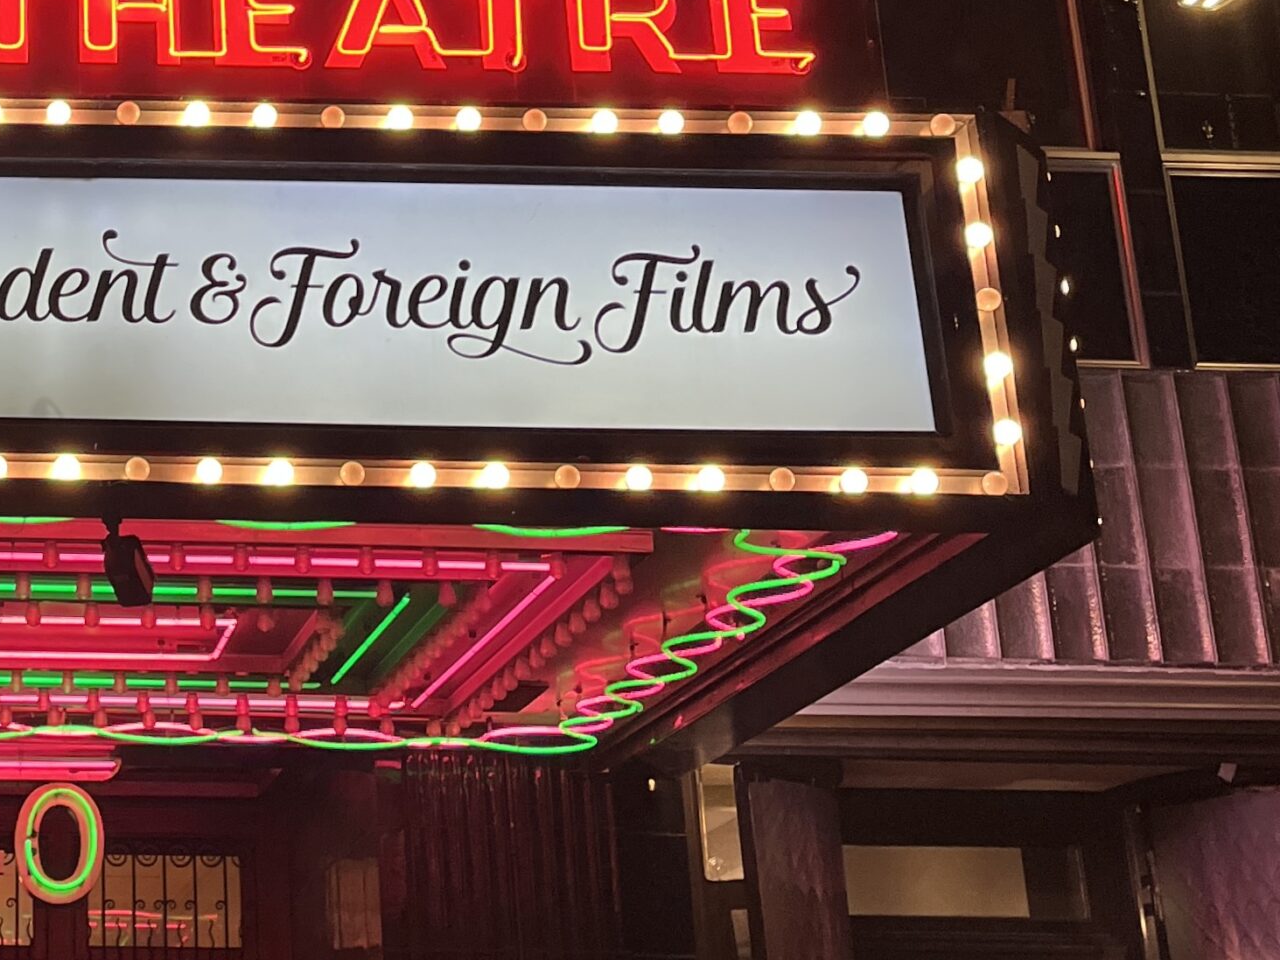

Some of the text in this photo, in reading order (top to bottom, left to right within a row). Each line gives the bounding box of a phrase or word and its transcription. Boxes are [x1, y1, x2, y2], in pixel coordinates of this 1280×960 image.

[189, 253, 247, 325] &
[249, 238, 593, 366] Foreign
[593, 243, 861, 353] Films
